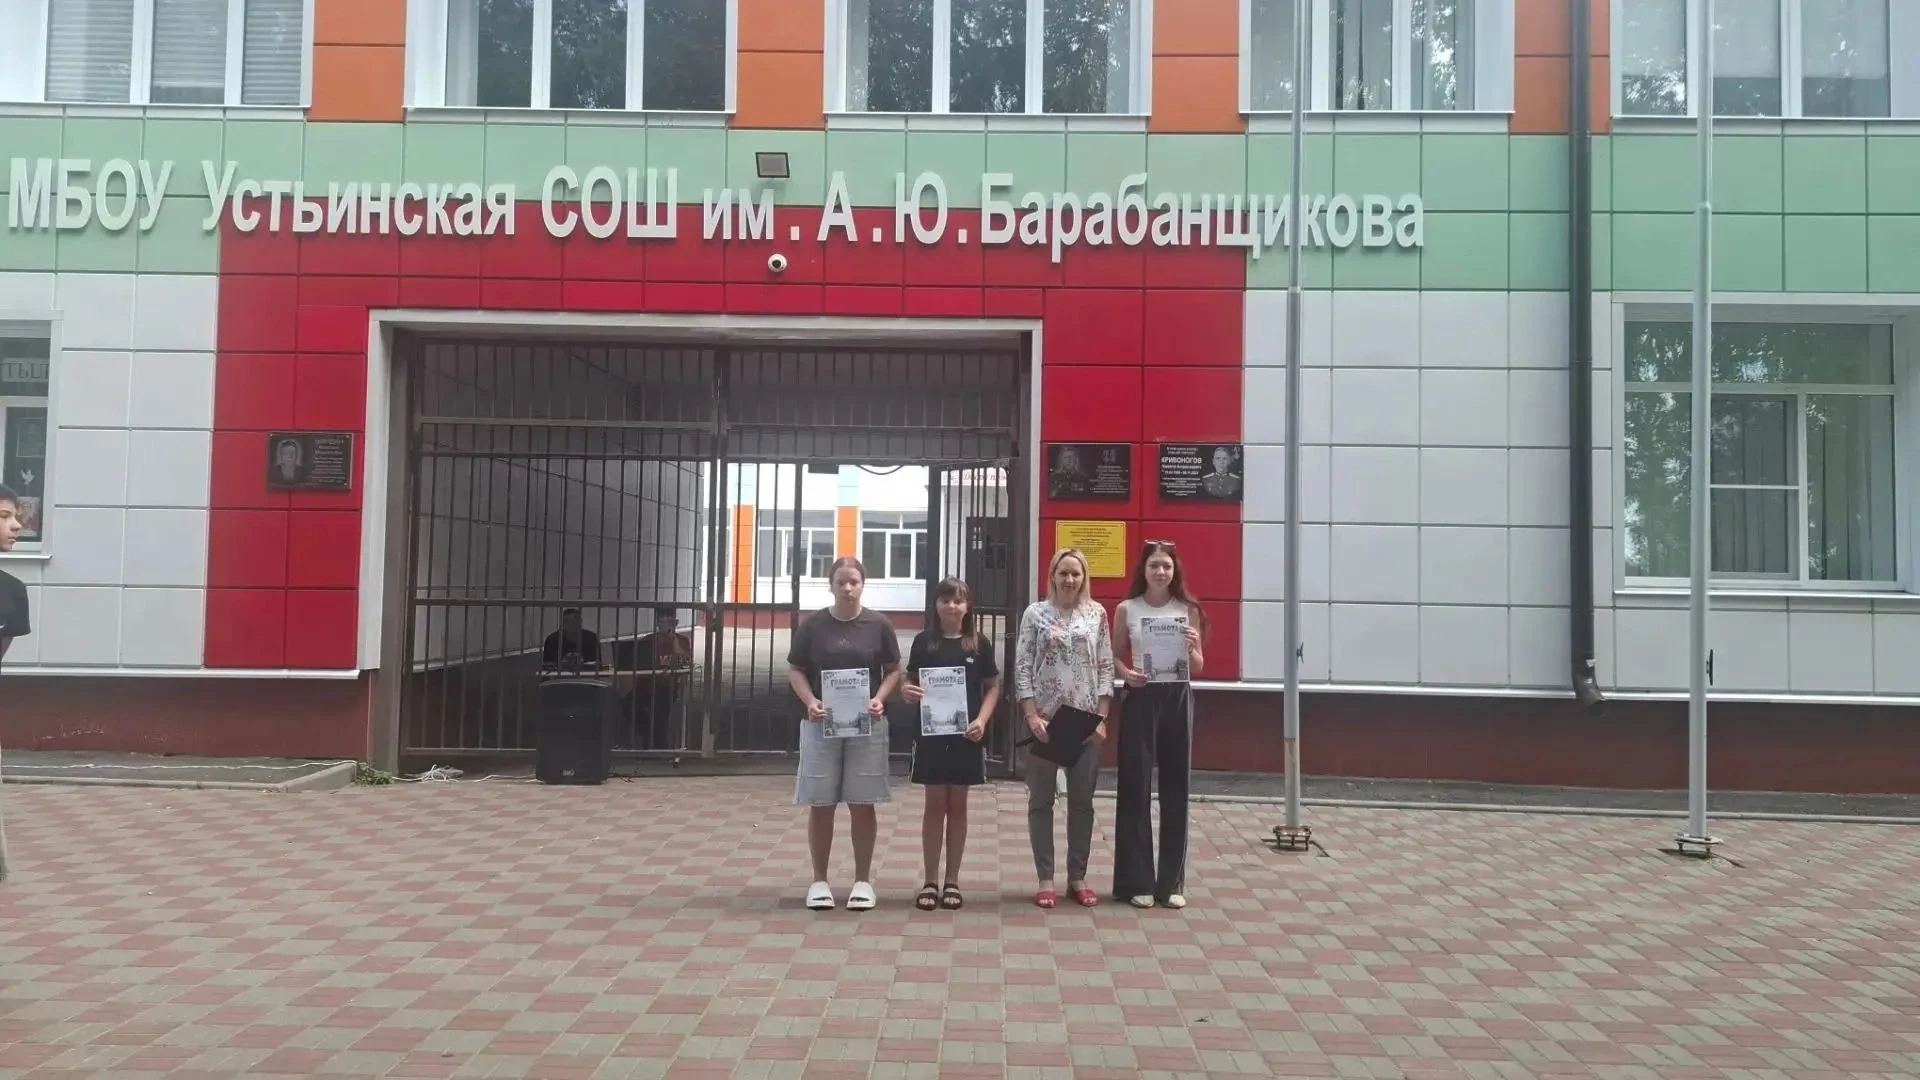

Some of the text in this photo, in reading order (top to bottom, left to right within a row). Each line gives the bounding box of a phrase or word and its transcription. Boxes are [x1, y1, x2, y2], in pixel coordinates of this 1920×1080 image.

[8, 157, 172, 233] МБОУ
[202, 160, 515, 236] Устьинская
[541, 165, 677, 240] СОШ
